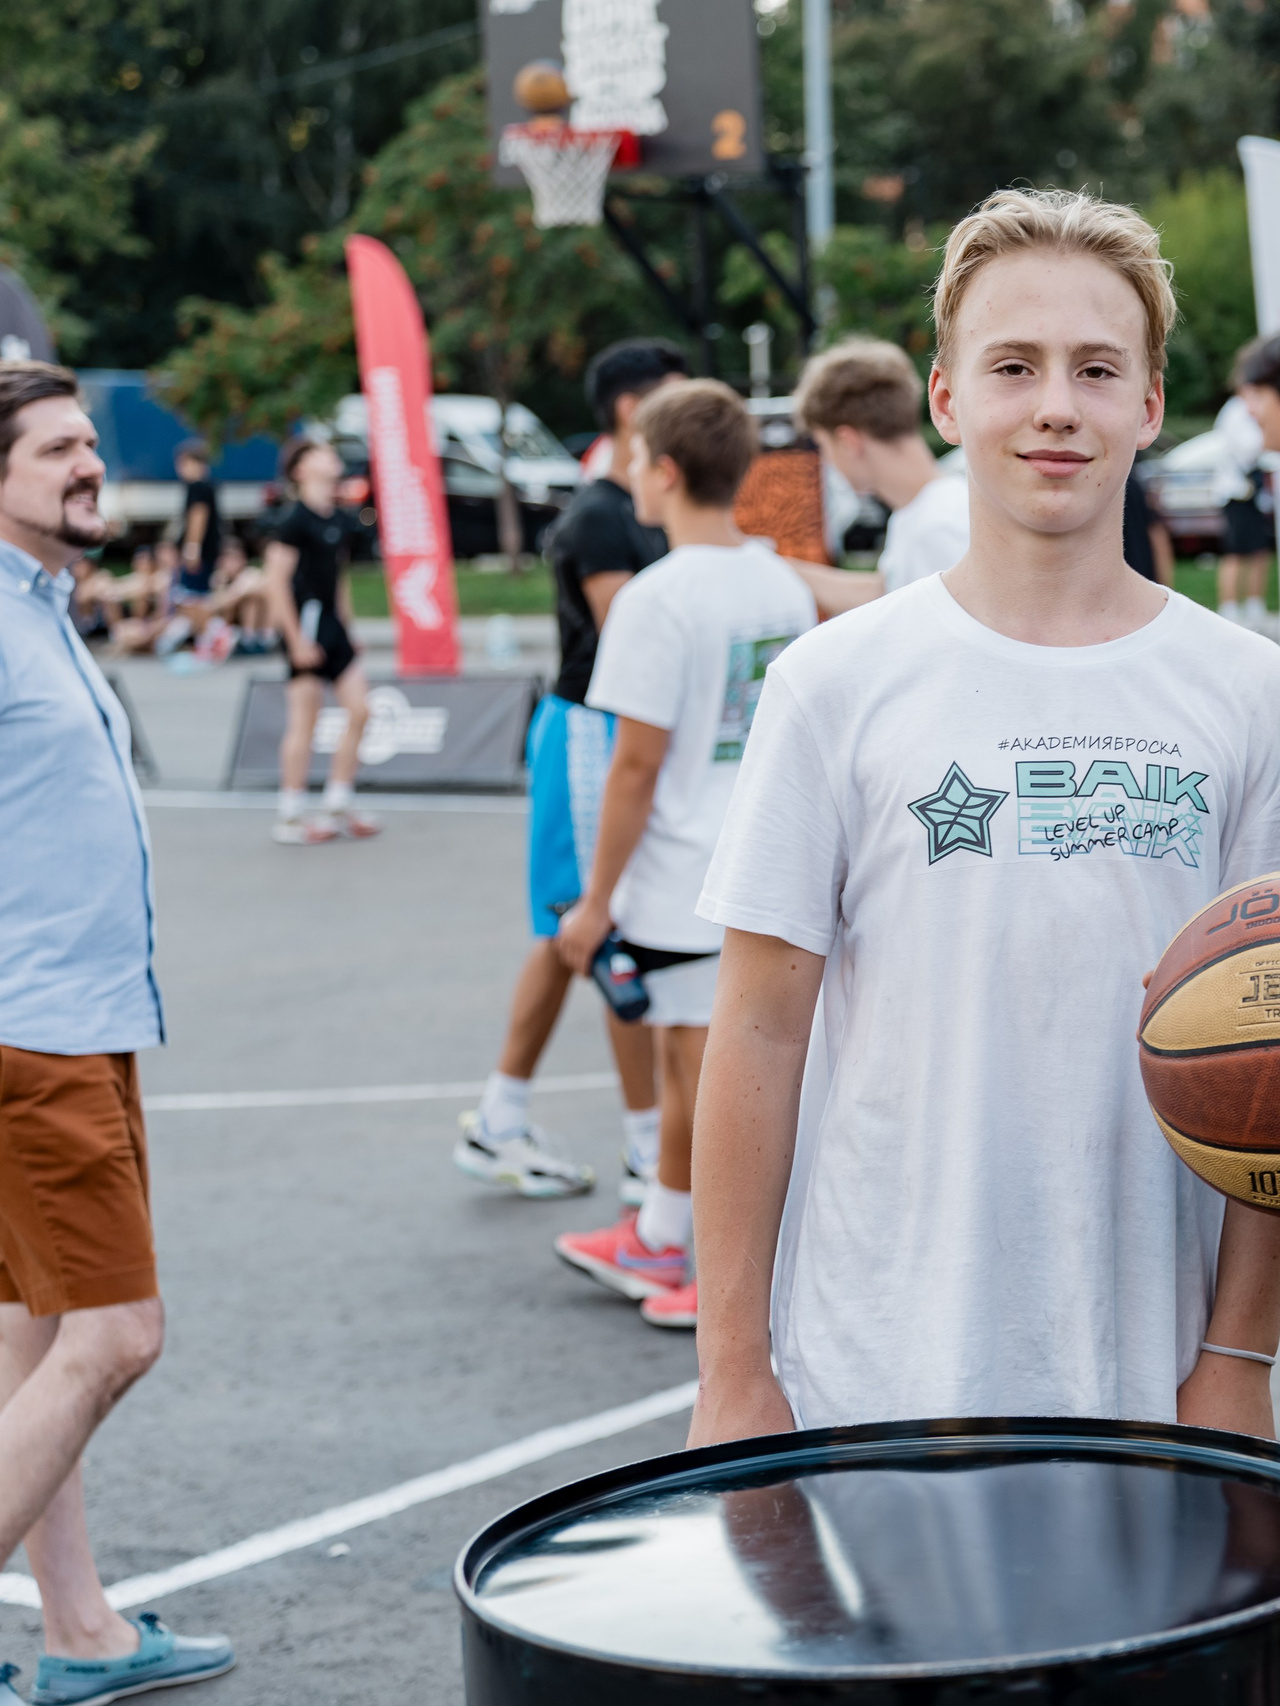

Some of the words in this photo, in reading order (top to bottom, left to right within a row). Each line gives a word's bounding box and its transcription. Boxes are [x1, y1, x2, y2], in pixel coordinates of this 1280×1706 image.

[1015, 760, 1210, 814] BAIK
[1044, 813, 1100, 842] LEVEL
[1104, 804, 1126, 824] UP
[1050, 827, 1129, 861] SUMMER
[1132, 818, 1179, 840] CAMP
